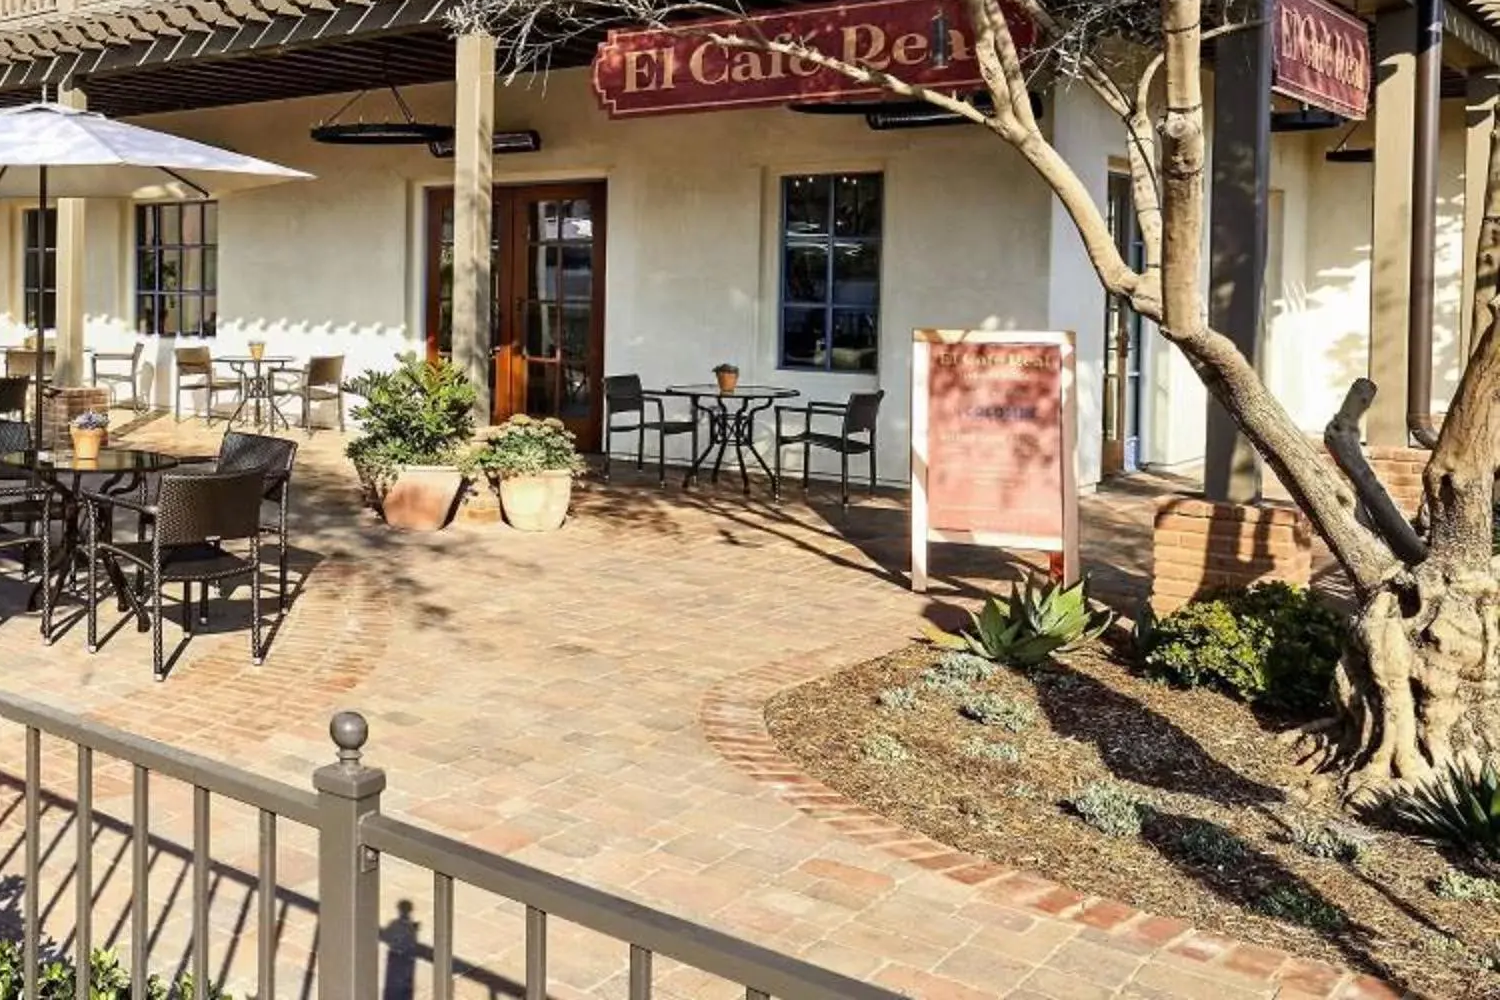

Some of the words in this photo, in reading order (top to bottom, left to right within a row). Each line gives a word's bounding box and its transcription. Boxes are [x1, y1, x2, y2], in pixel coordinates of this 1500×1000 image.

[622, 46, 676, 93] El
[689, 28, 822, 86] Café
[840, 22, 975, 72] Rea
[1281, 4, 1301, 61] El
